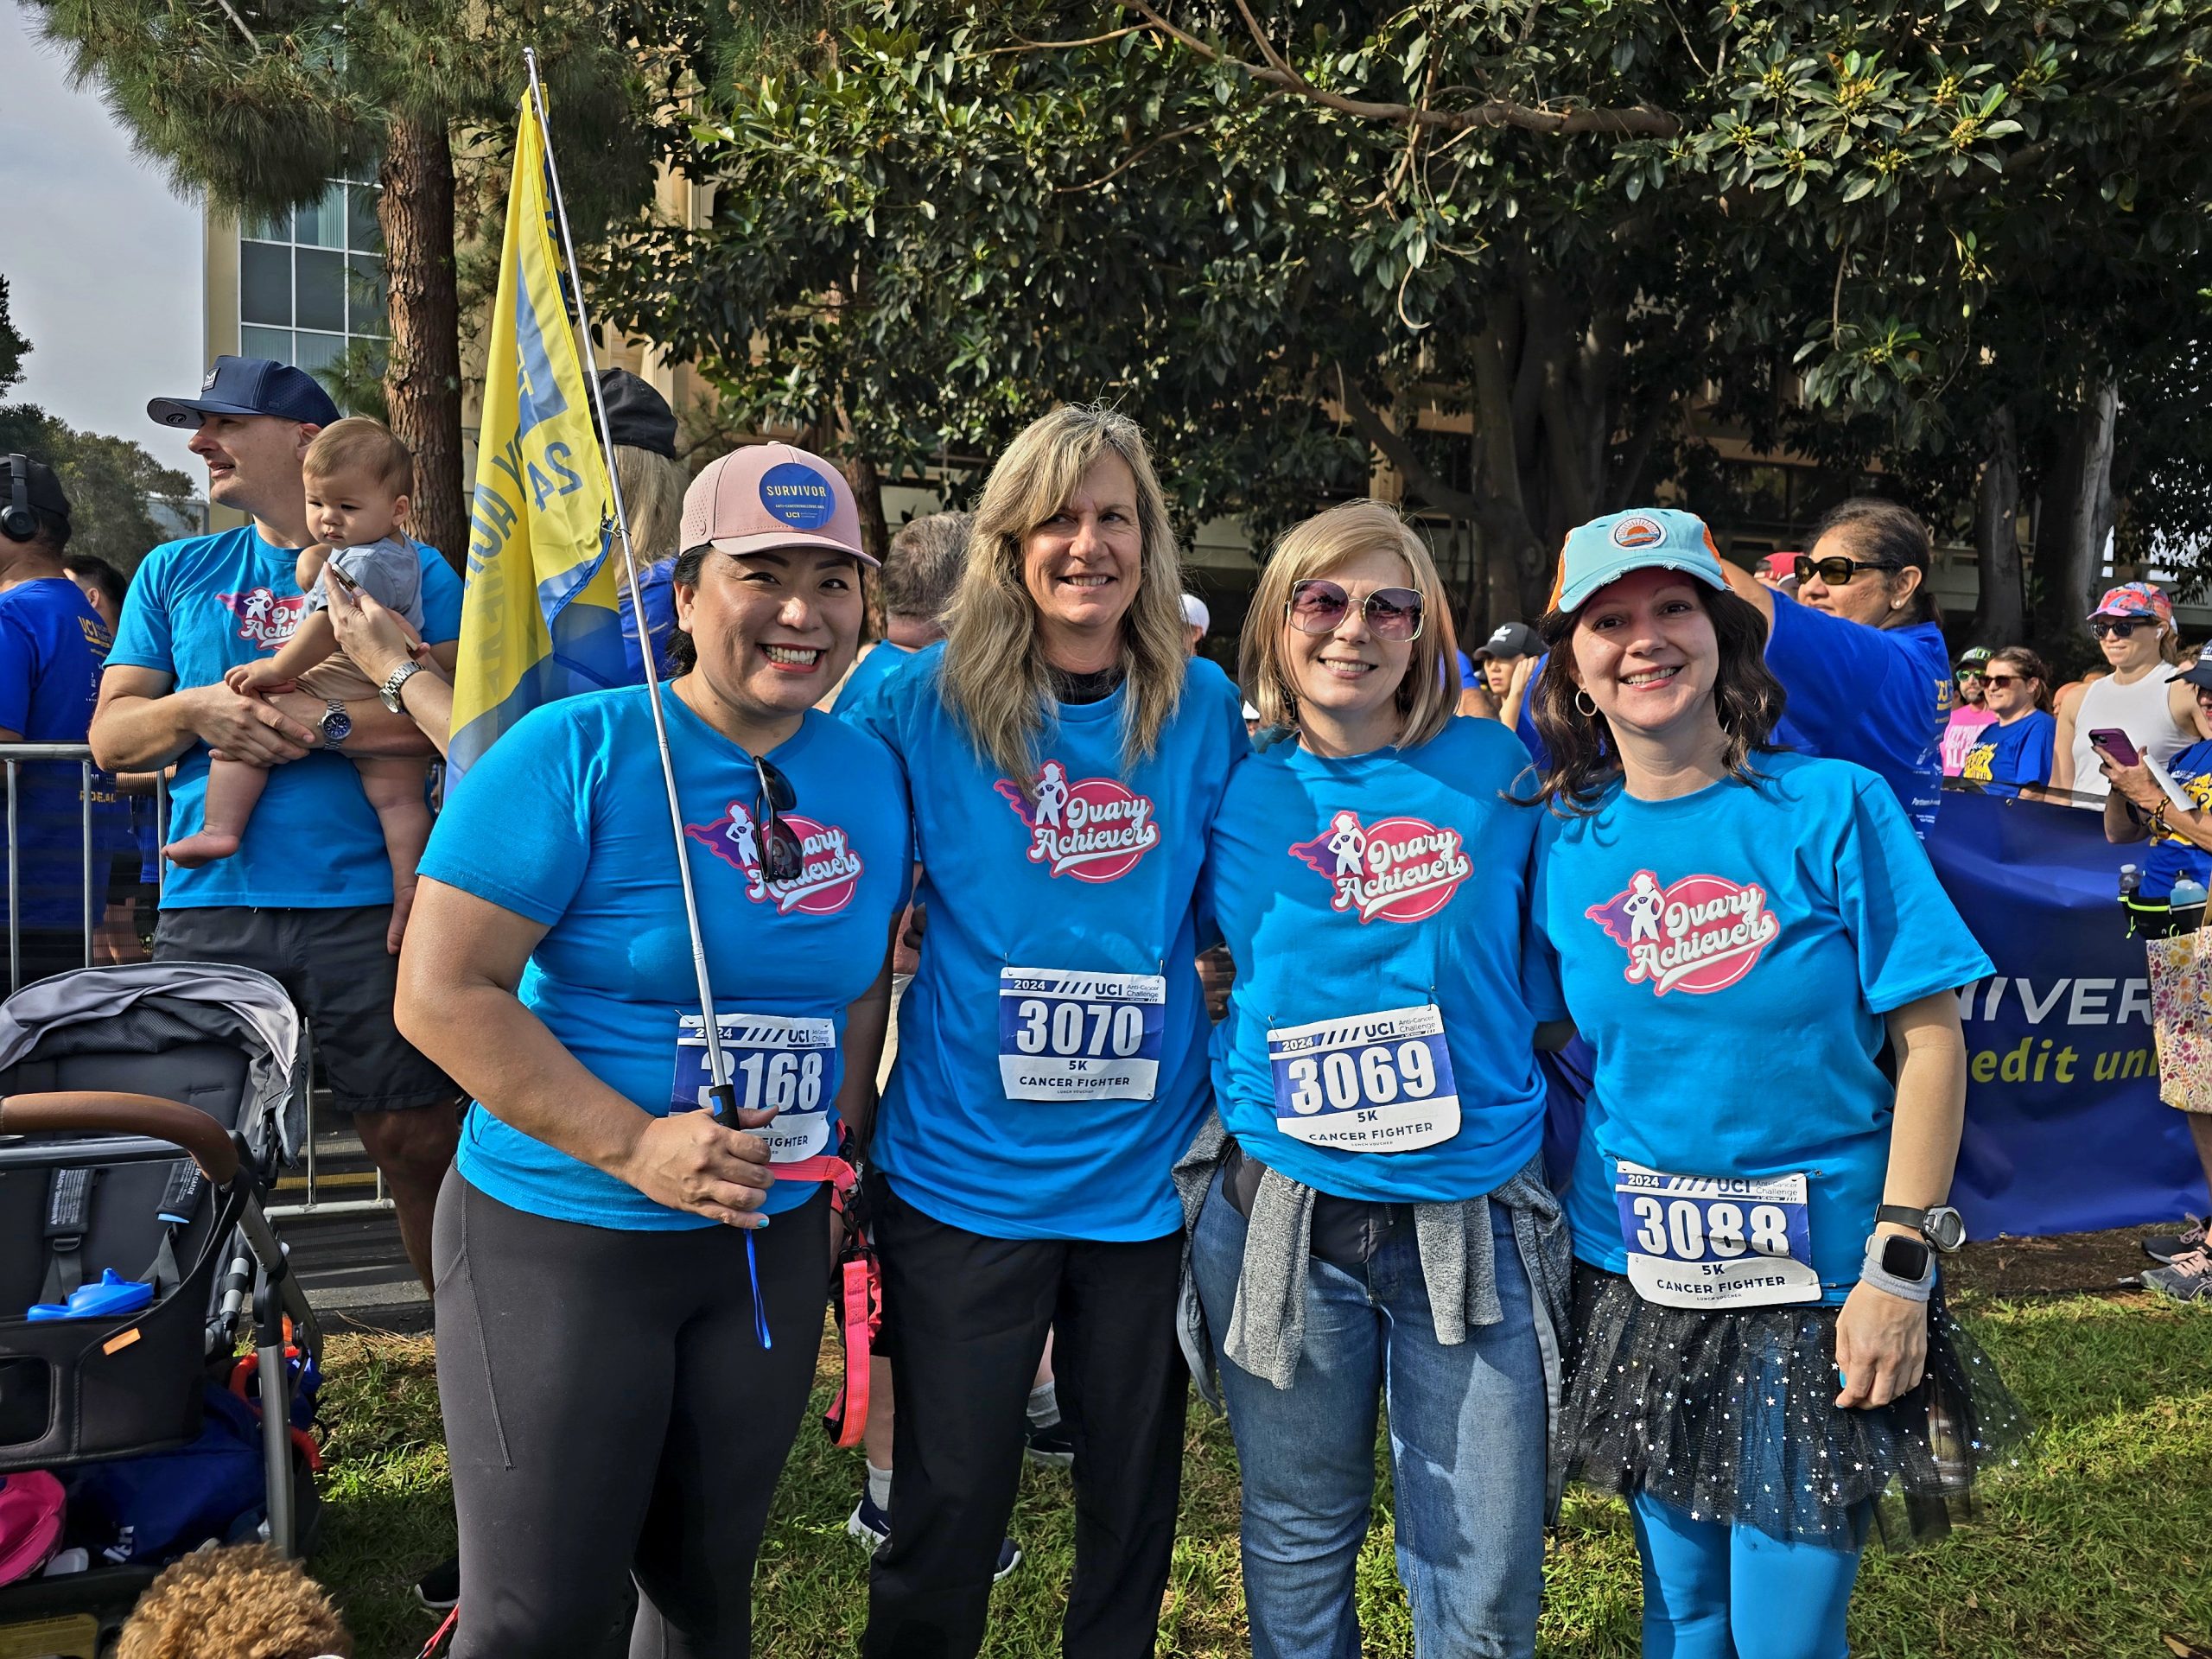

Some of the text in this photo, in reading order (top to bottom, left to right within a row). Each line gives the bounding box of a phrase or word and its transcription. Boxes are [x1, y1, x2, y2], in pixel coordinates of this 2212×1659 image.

[766, 485, 826, 498] SURVIVOR
[1066, 798, 1149, 830] Ovary
[1030, 824, 1156, 861] Achievers
[1367, 831, 1458, 874] Ovary
[1334, 855, 1469, 907] Achievers
[1664, 887, 1763, 938] Ovary
[1629, 914, 1776, 979] Achievers
[1014, 980, 1122, 996] 2024 UCI
[1127, 989, 1159, 998] Challenge
[1017, 1000, 1144, 1057] 3070
[1398, 1015, 1434, 1026] Anti-Cancer
[1399, 1022, 1436, 1033] Challenge
[695, 1027, 810, 1043] 224 UCI
[1281, 1021, 1395, 1052] 2024 UCI
[1069, 1060, 1088, 1071] 5K
[1020, 1076, 1130, 1087] CANCER FIGHTER
[1288, 1040, 1436, 1115] 3069
[1357, 1110, 1379, 1123] 5K
[1309, 1122, 1433, 1141] CANCER FIGHTER
[1627, 1174, 1751, 1193] 2024 UCI
[1756, 1179, 1798, 1188] Anti-Cancer
[1756, 1186, 1798, 1197] Challenge
[1633, 1197, 1789, 1260] 3088
[1701, 1263, 1726, 1276] 5K
[1657, 1276, 1786, 1294] CANCER FIGHTER
